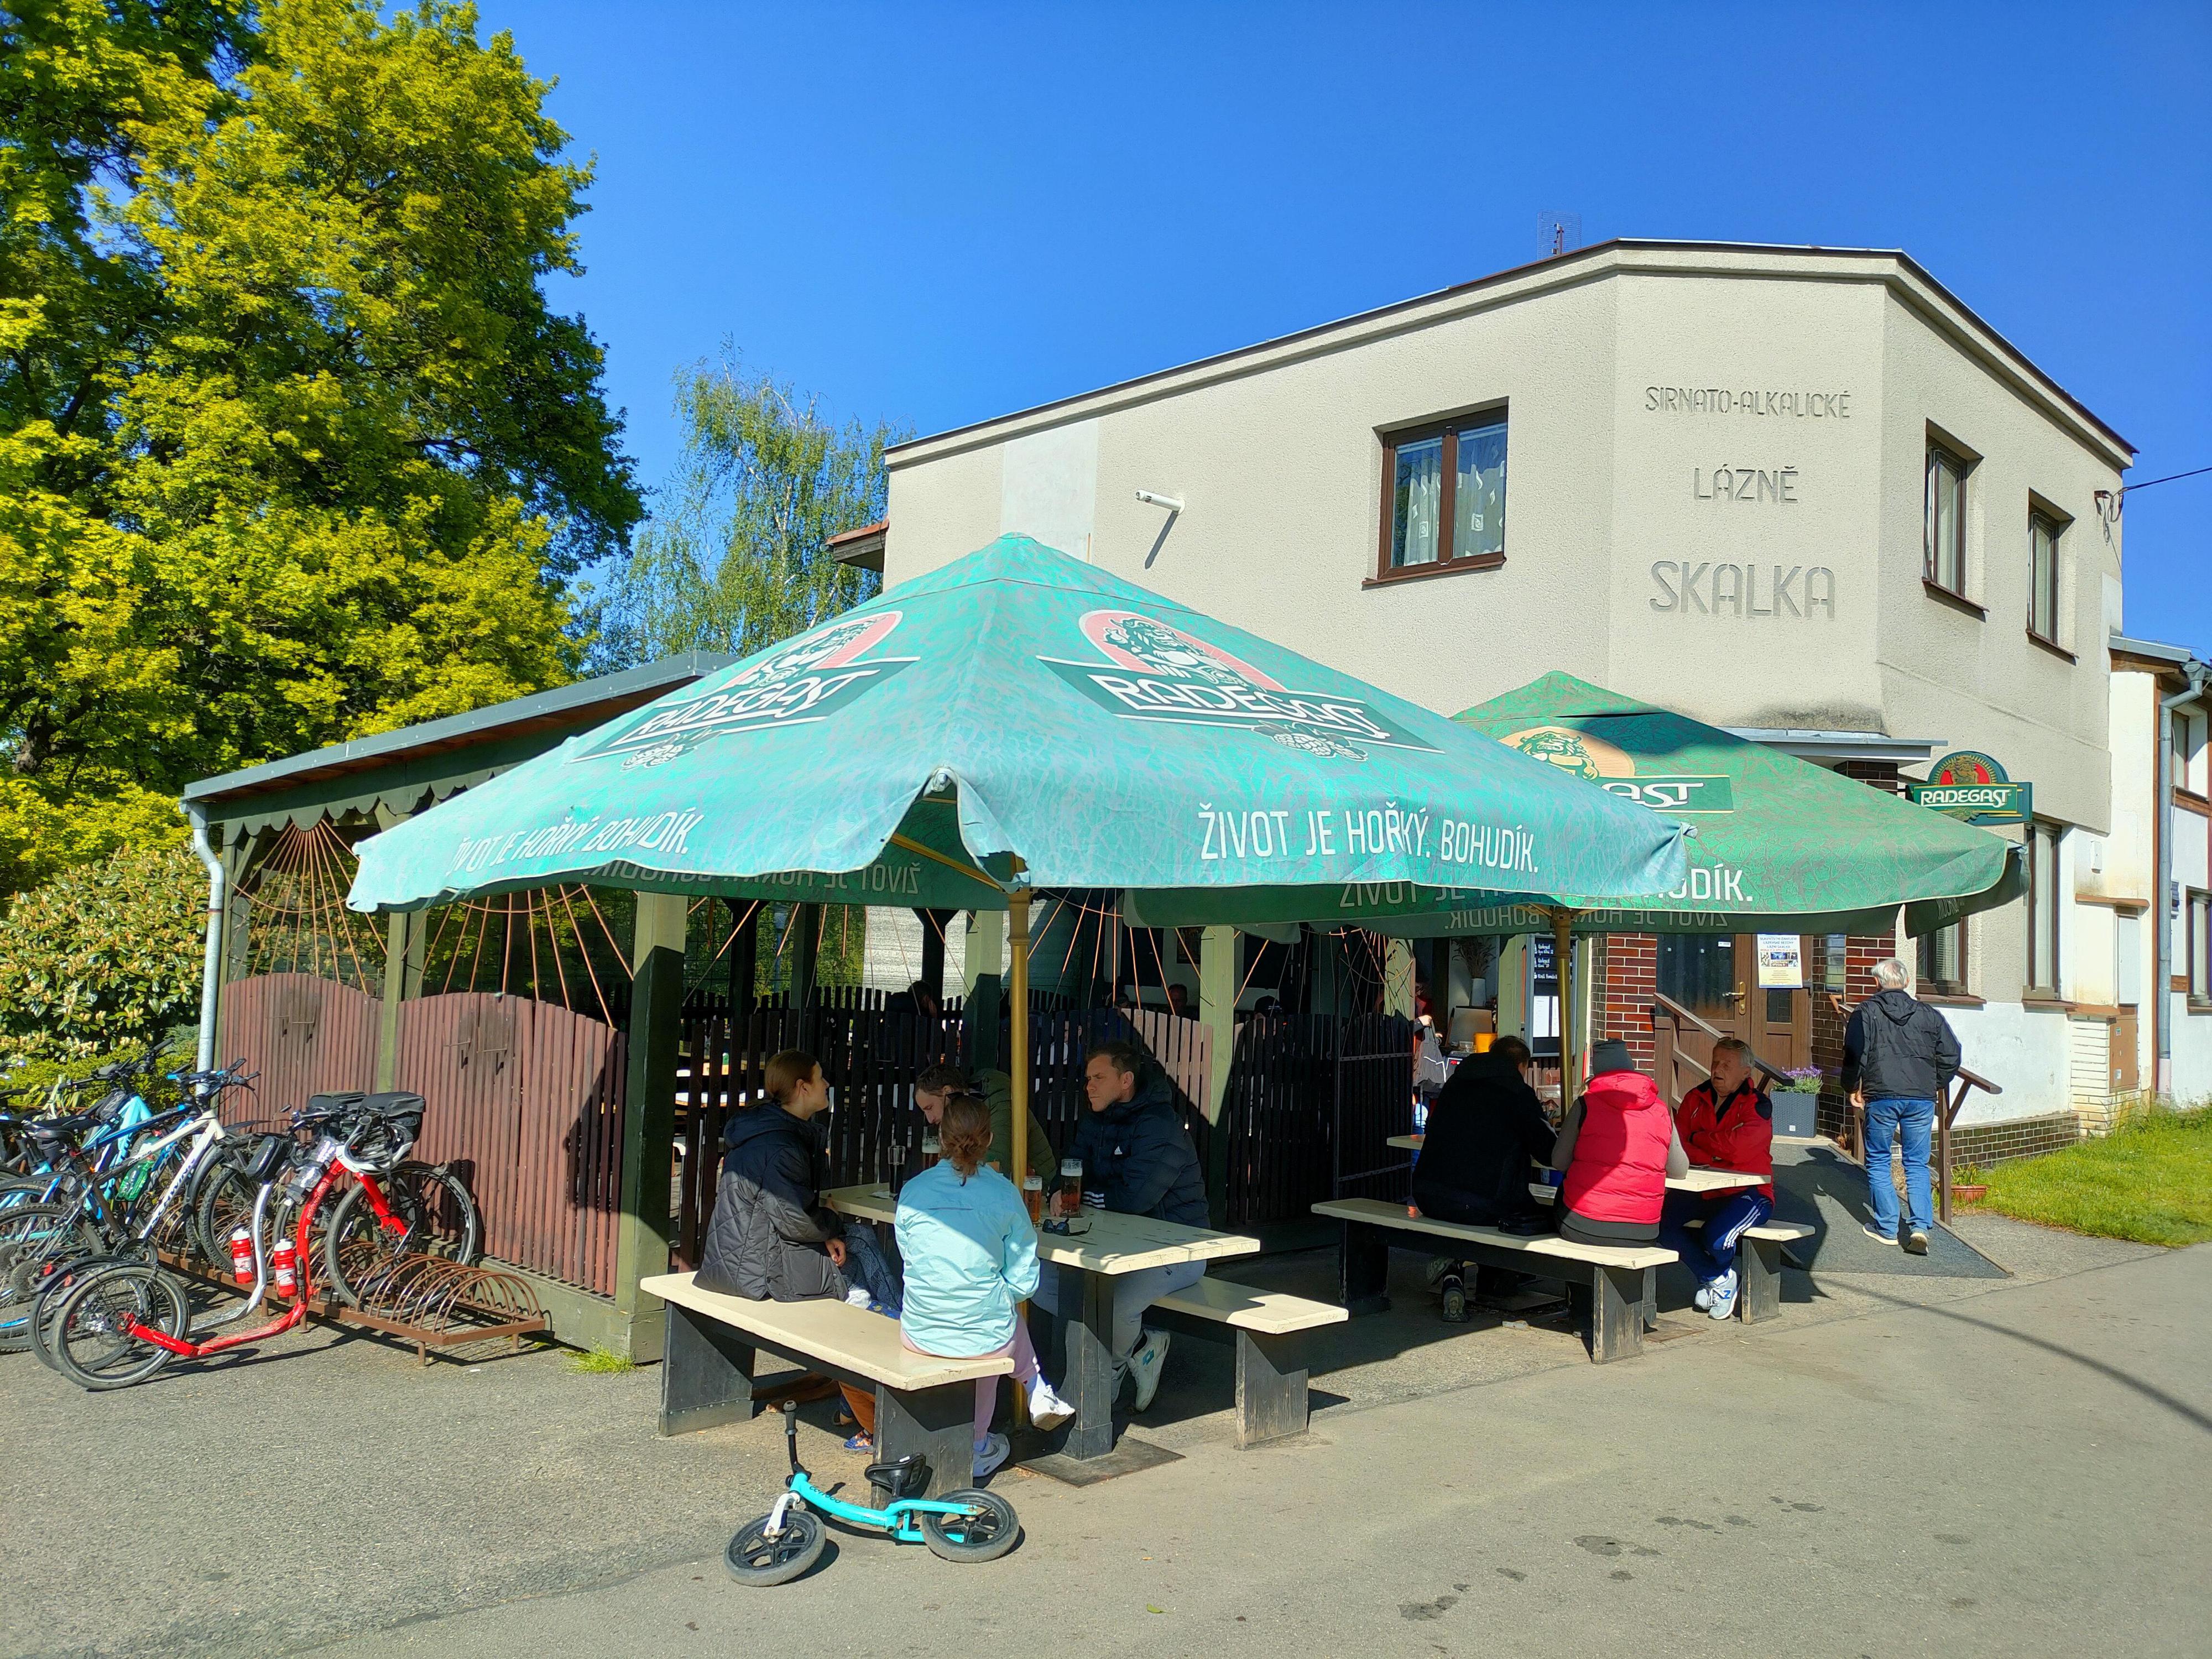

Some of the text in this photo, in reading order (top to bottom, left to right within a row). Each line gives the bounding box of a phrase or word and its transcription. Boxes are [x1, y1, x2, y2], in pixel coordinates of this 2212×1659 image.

[1645, 387, 1851, 418] SIRNATO-ALKALICKÉ
[1693, 463, 1799, 504] LÁZNĚ
[1649, 560, 1836, 620] SKALKA
[607, 669, 881, 747] RADEGAST
[1087, 674, 1391, 740] RADEGAST
[1921, 789, 2011, 808] RADEGAST
[581, 807, 705, 854] BOHUDÍK.
[1198, 801, 1538, 873] ŽIVOT JE HOŘKÝ. BOHUDÍK.
